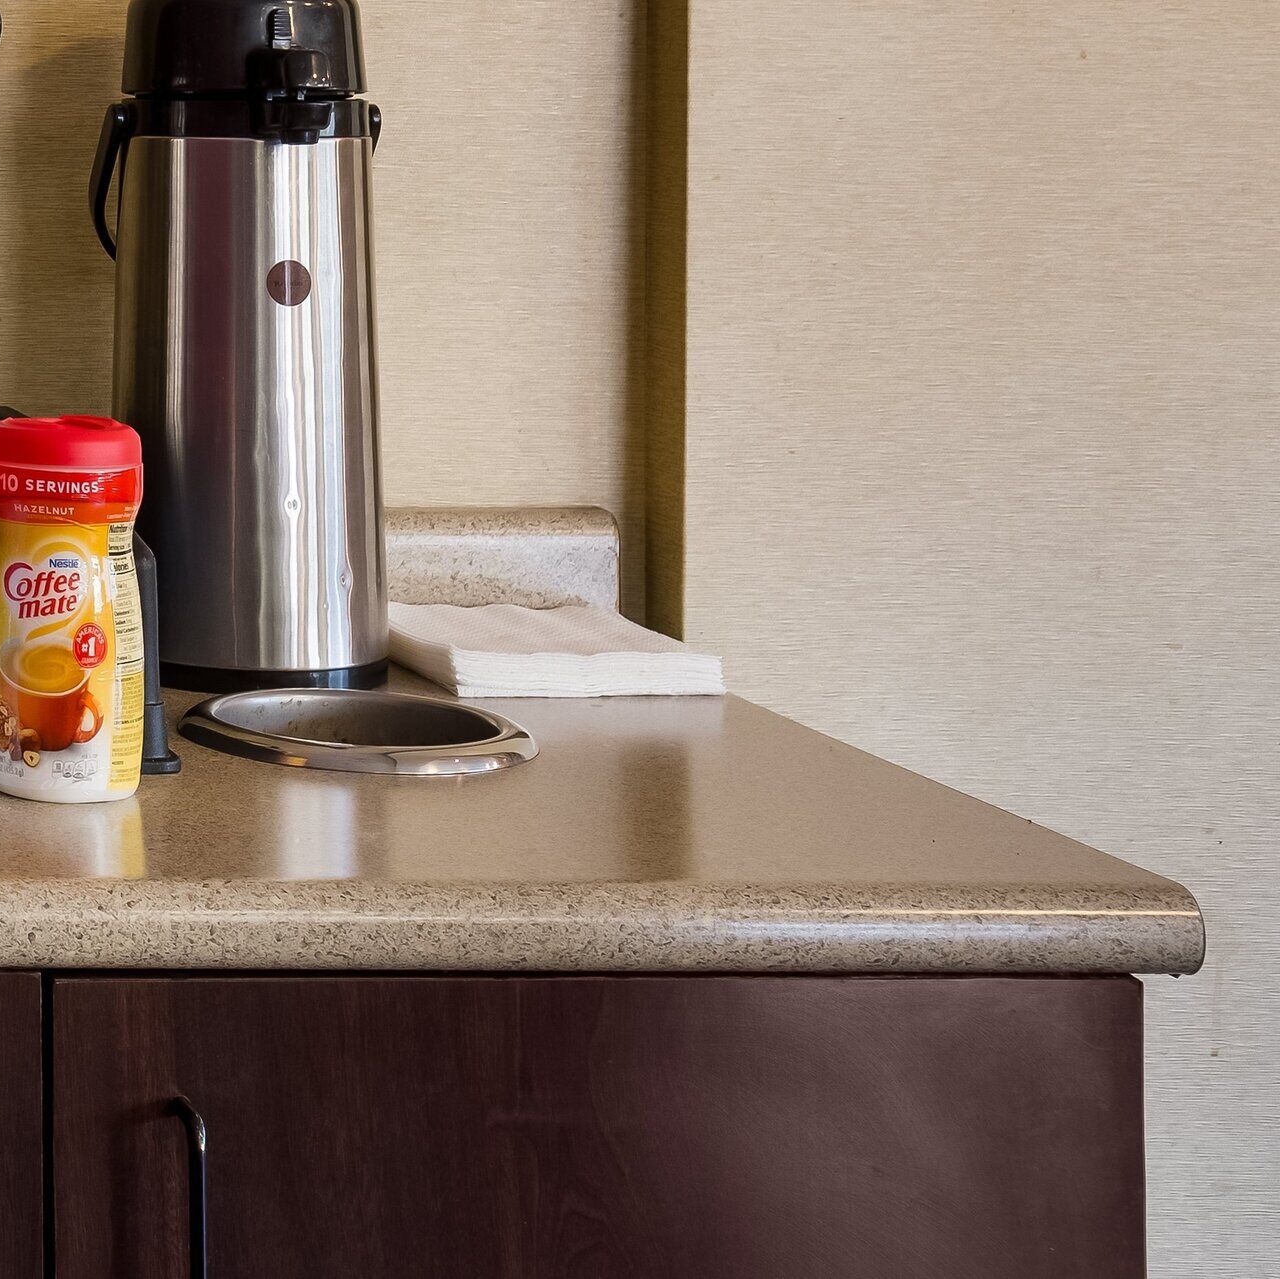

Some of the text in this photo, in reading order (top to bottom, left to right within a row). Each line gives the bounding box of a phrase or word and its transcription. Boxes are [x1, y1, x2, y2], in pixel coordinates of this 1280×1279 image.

[25, 479, 100, 494] SERVINGS
[14, 503, 75, 516] HAZELNUT
[3, 562, 81, 602] Coffee
[18, 594, 77, 619] mate
[76, 626, 105, 645] AMERICA'S
[81, 636, 96, 657] #1
